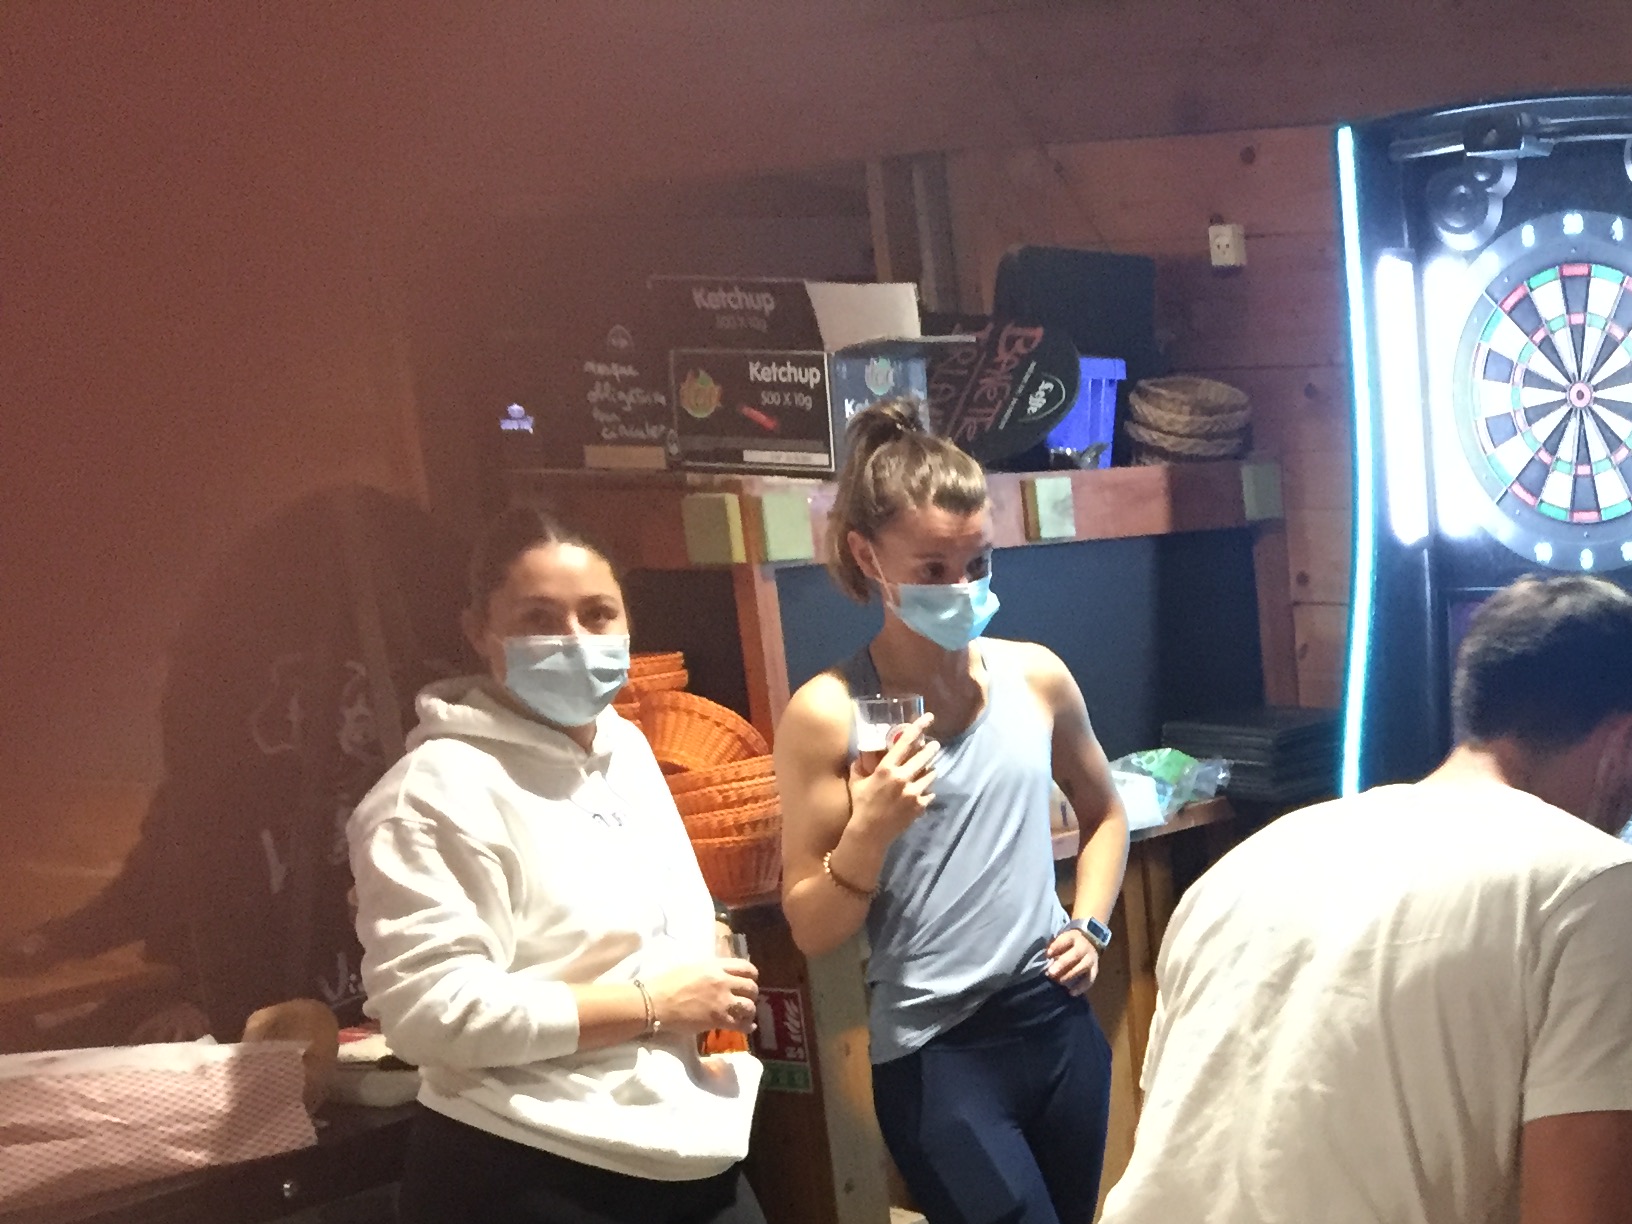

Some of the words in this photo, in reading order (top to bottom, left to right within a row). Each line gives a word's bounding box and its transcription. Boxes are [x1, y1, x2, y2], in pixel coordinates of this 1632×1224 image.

[692, 285, 775, 317] Ketchup
[748, 361, 821, 389] Ketchup
[760, 390, 782, 406] 500
[793, 391, 813, 411] 10g
